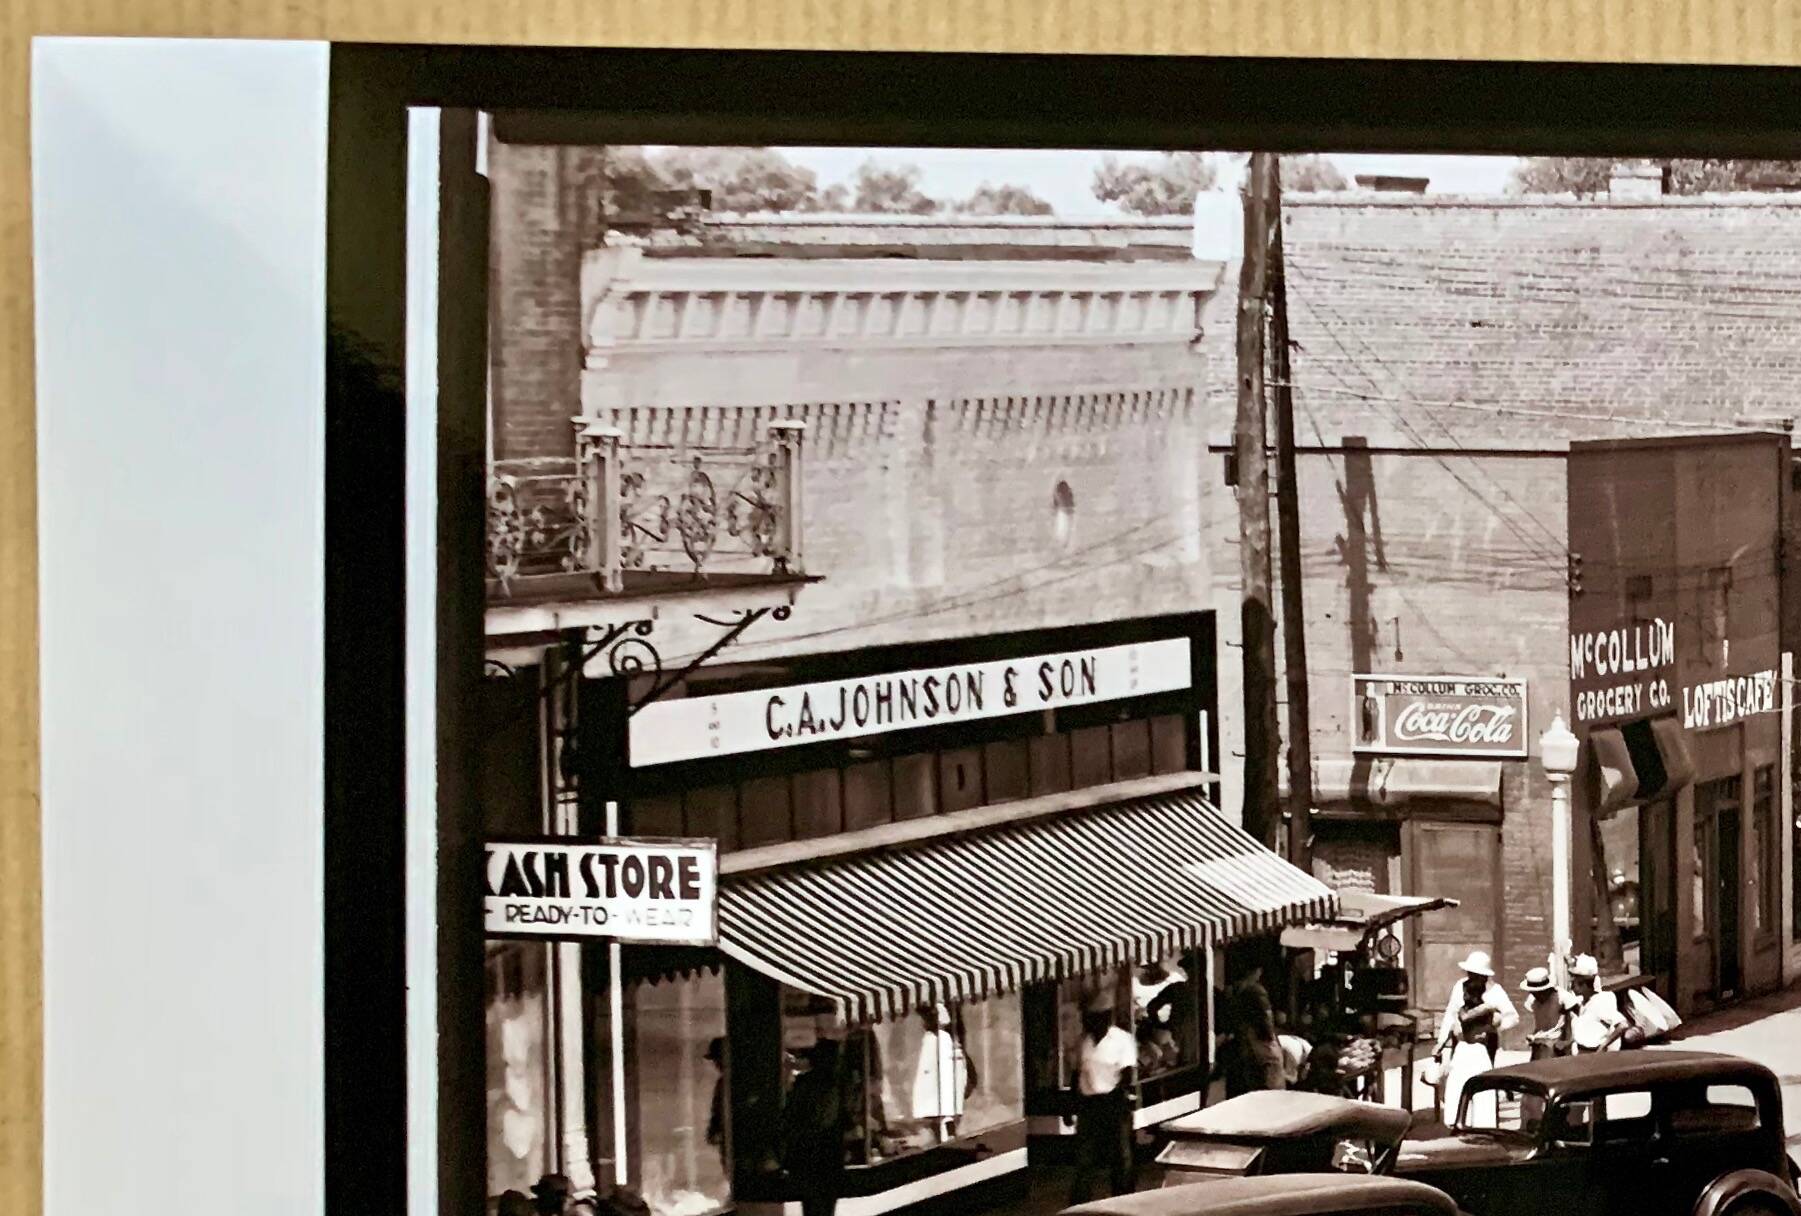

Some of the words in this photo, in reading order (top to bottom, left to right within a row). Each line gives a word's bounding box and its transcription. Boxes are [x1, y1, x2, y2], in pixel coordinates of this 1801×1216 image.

[1571, 617, 1674, 680] McCOLLUM
[1004, 666, 1018, 707] &
[1038, 656, 1096, 702] SON
[1577, 683, 1643, 721] GROCERY
[1650, 679, 1671, 708] CO.
[1683, 678, 1736, 729] LOFTIS
[1394, 701, 1517, 743] Coca-Cola
[579, 853, 700, 899] STORE
